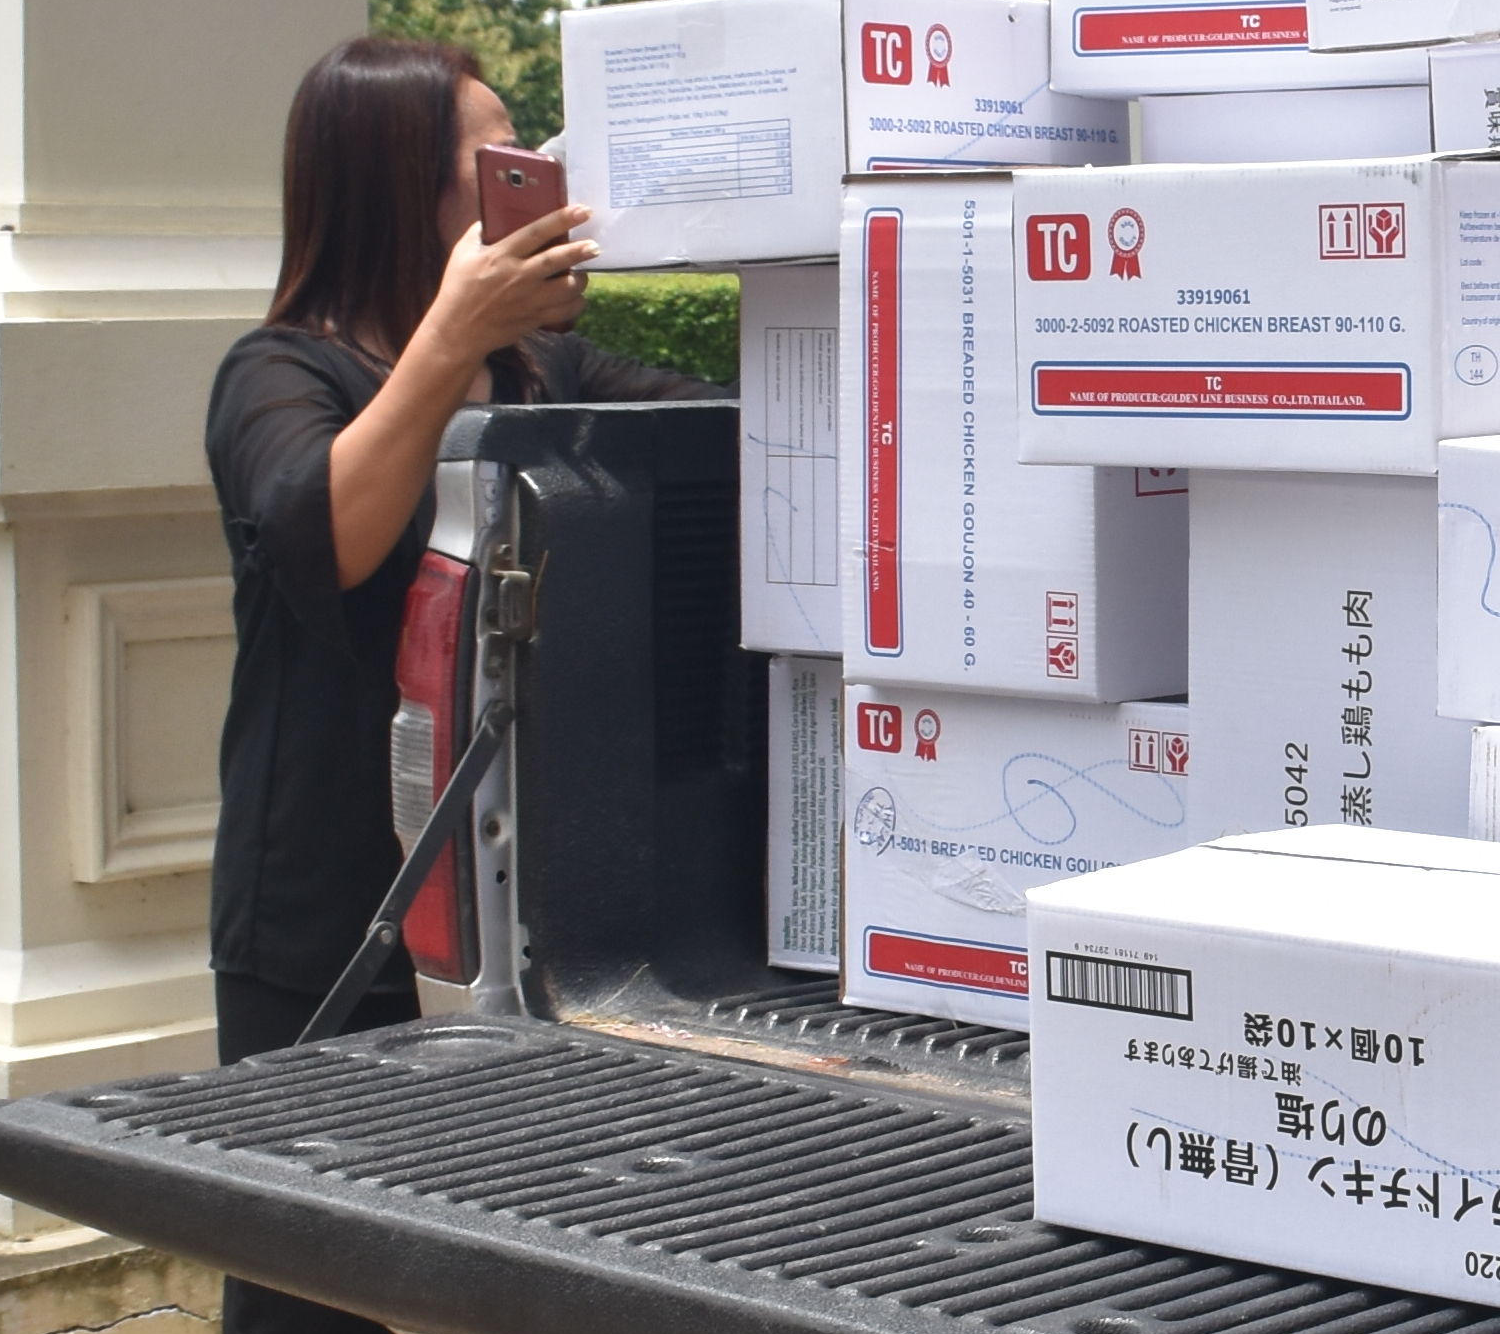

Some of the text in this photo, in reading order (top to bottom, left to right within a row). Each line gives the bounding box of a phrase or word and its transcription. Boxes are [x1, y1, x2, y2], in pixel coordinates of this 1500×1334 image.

[1240, 13, 1260, 28] TC
[1122, 36, 1144, 44] NAME
[1148, 35, 1159, 43] OF
[1262, 31, 1300, 39] BUSINESS
[870, 30, 903, 78] TC
[975, 98, 1024, 115] 33919061
[869, 117, 1119, 144] 3000-2-5092 ROASTED CHICKEN BREAST 90-110 G.
[962, 200, 976, 304] 5301-1-5031
[1037, 222, 1077, 274] TC
[1177, 289, 1251, 305] 33919061
[1035, 316, 1405, 333] 3000-2-5092 ROASTED CHICKEN BREAST 90-110 G.
[963, 312, 974, 405] BREADED
[1470, 351, 1482, 363] TH
[1205, 376, 1222, 391] TC
[1070, 392, 1095, 401] NAME
[1097, 392, 1109, 402] OF
[1200, 394, 1223, 404] LINE
[1225, 394, 1269, 404] BUSINESS
[882, 421, 893, 446] TC
[963, 411, 975, 496] CHICKEN
[963, 502, 974, 583] GOUJON
[963, 589, 975, 609] 40
[964, 626, 975, 647] 60
[964, 653, 976, 671] G.
[865, 708, 894, 747] TC
[1284, 741, 1309, 827] 5042
[998, 846, 1059, 871] CHICKEN
[1242, 1010, 1426, 1066] 10個×10袋
[1122, 1037, 1303, 1086] 油で揚げてあります
[1274, 1091, 1387, 1147] のり塩
